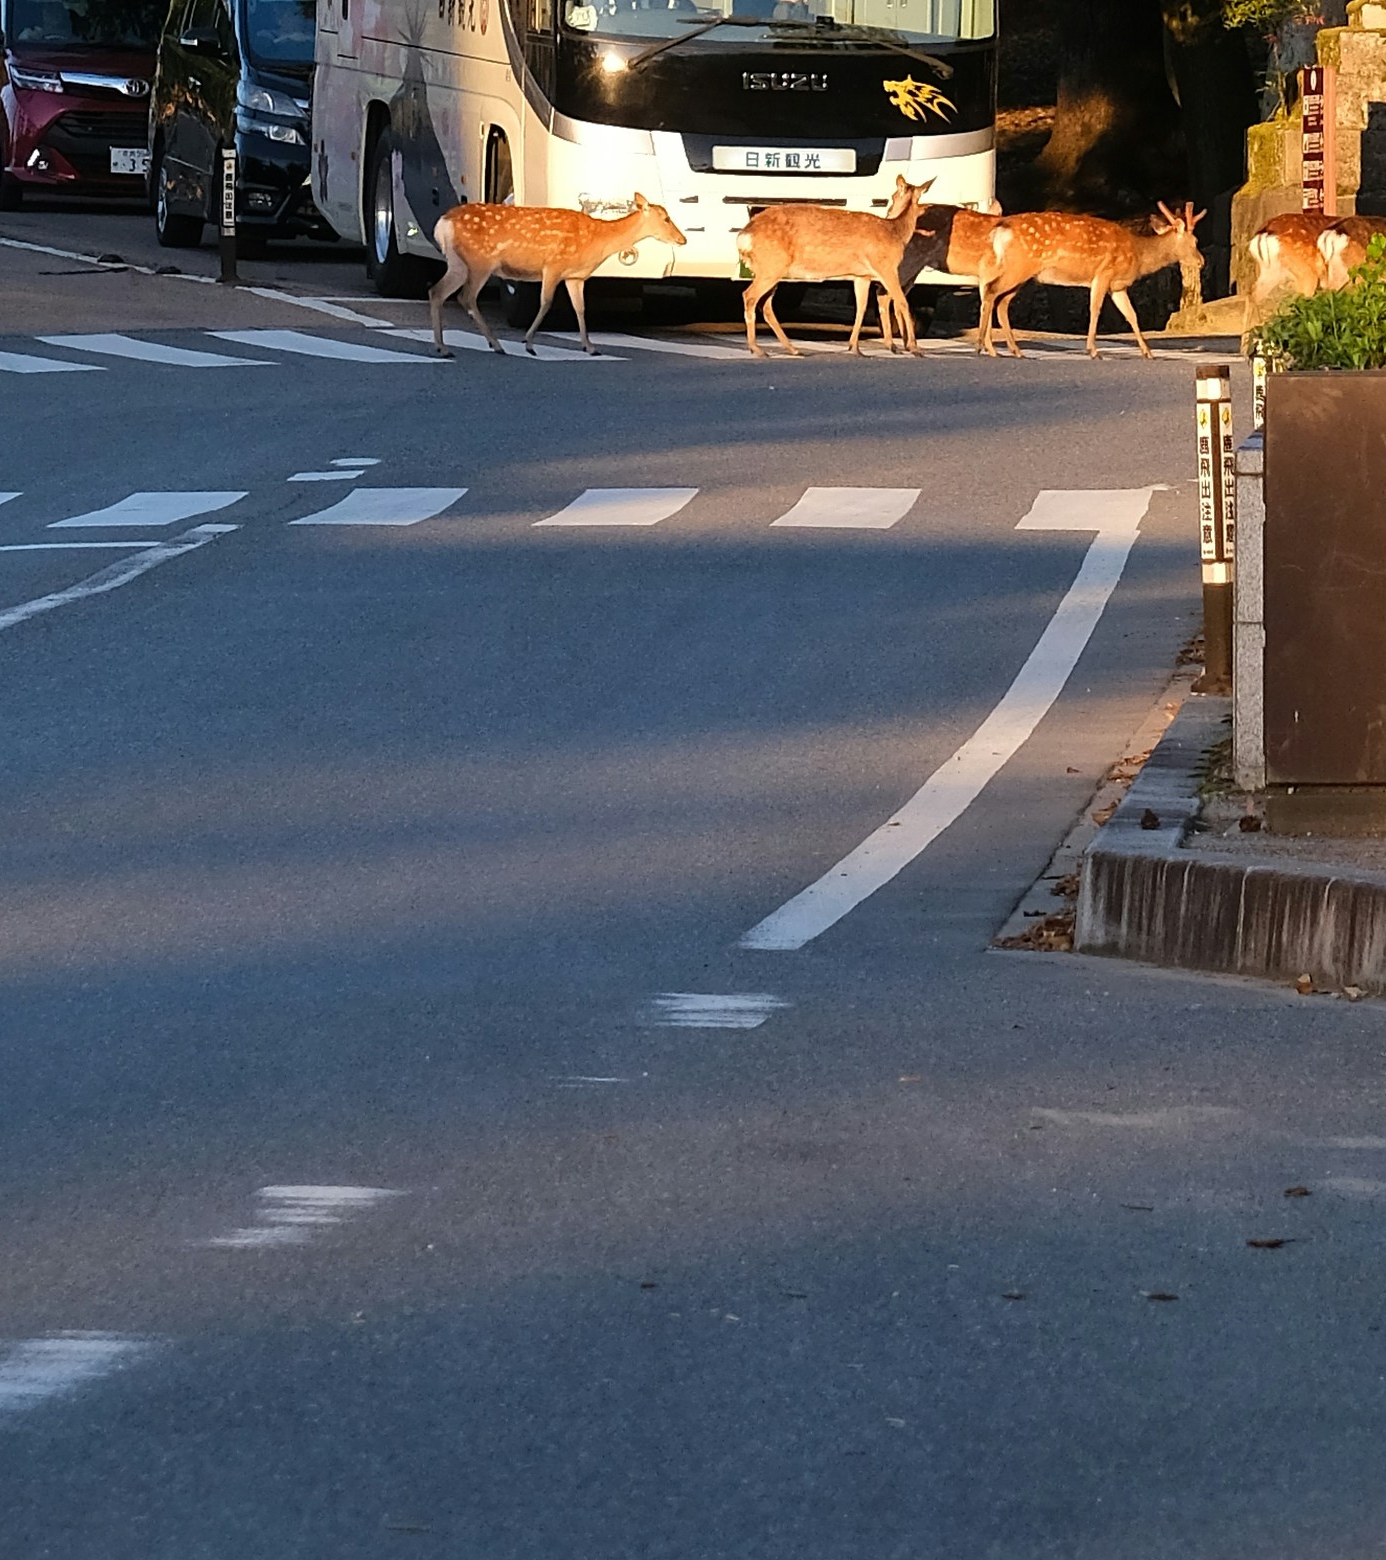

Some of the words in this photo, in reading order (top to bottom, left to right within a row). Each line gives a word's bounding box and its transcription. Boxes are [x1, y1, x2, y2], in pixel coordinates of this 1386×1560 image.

[742, 71, 828, 91] ISUZU
[746, 151, 821, 169] 日新観光
[1199, 436, 1213, 544] 鹿飛出注意
